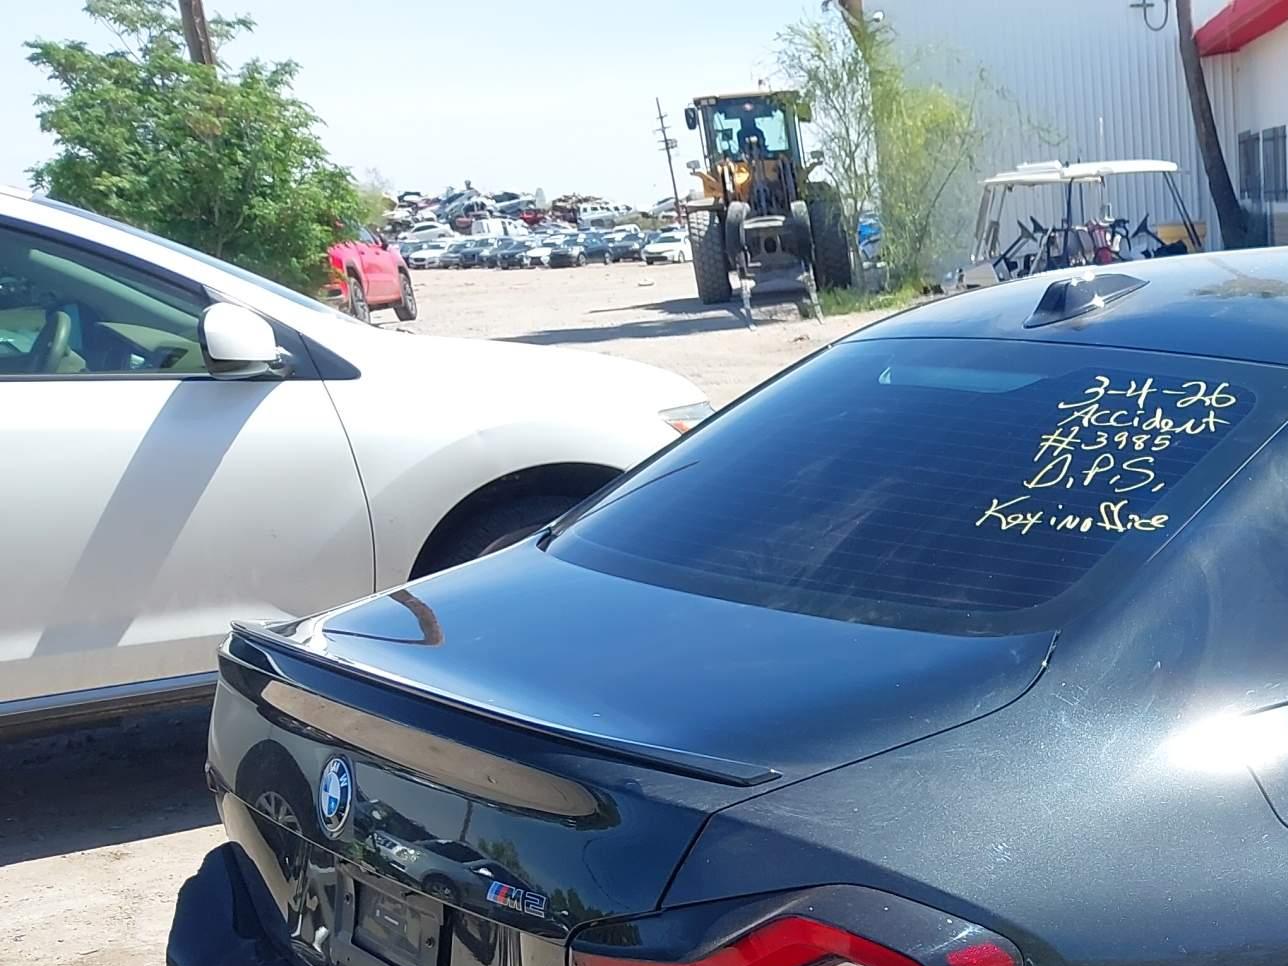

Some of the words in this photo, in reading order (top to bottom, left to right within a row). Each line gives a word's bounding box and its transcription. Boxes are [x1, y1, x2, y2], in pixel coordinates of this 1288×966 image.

[1057, 375, 1236, 409] 3-4-26
[1057, 403, 1231, 435] Accident
[1033, 426, 1172, 462] #3985
[975, 495, 1044, 535] Key
[499, 883, 546, 918] M2
